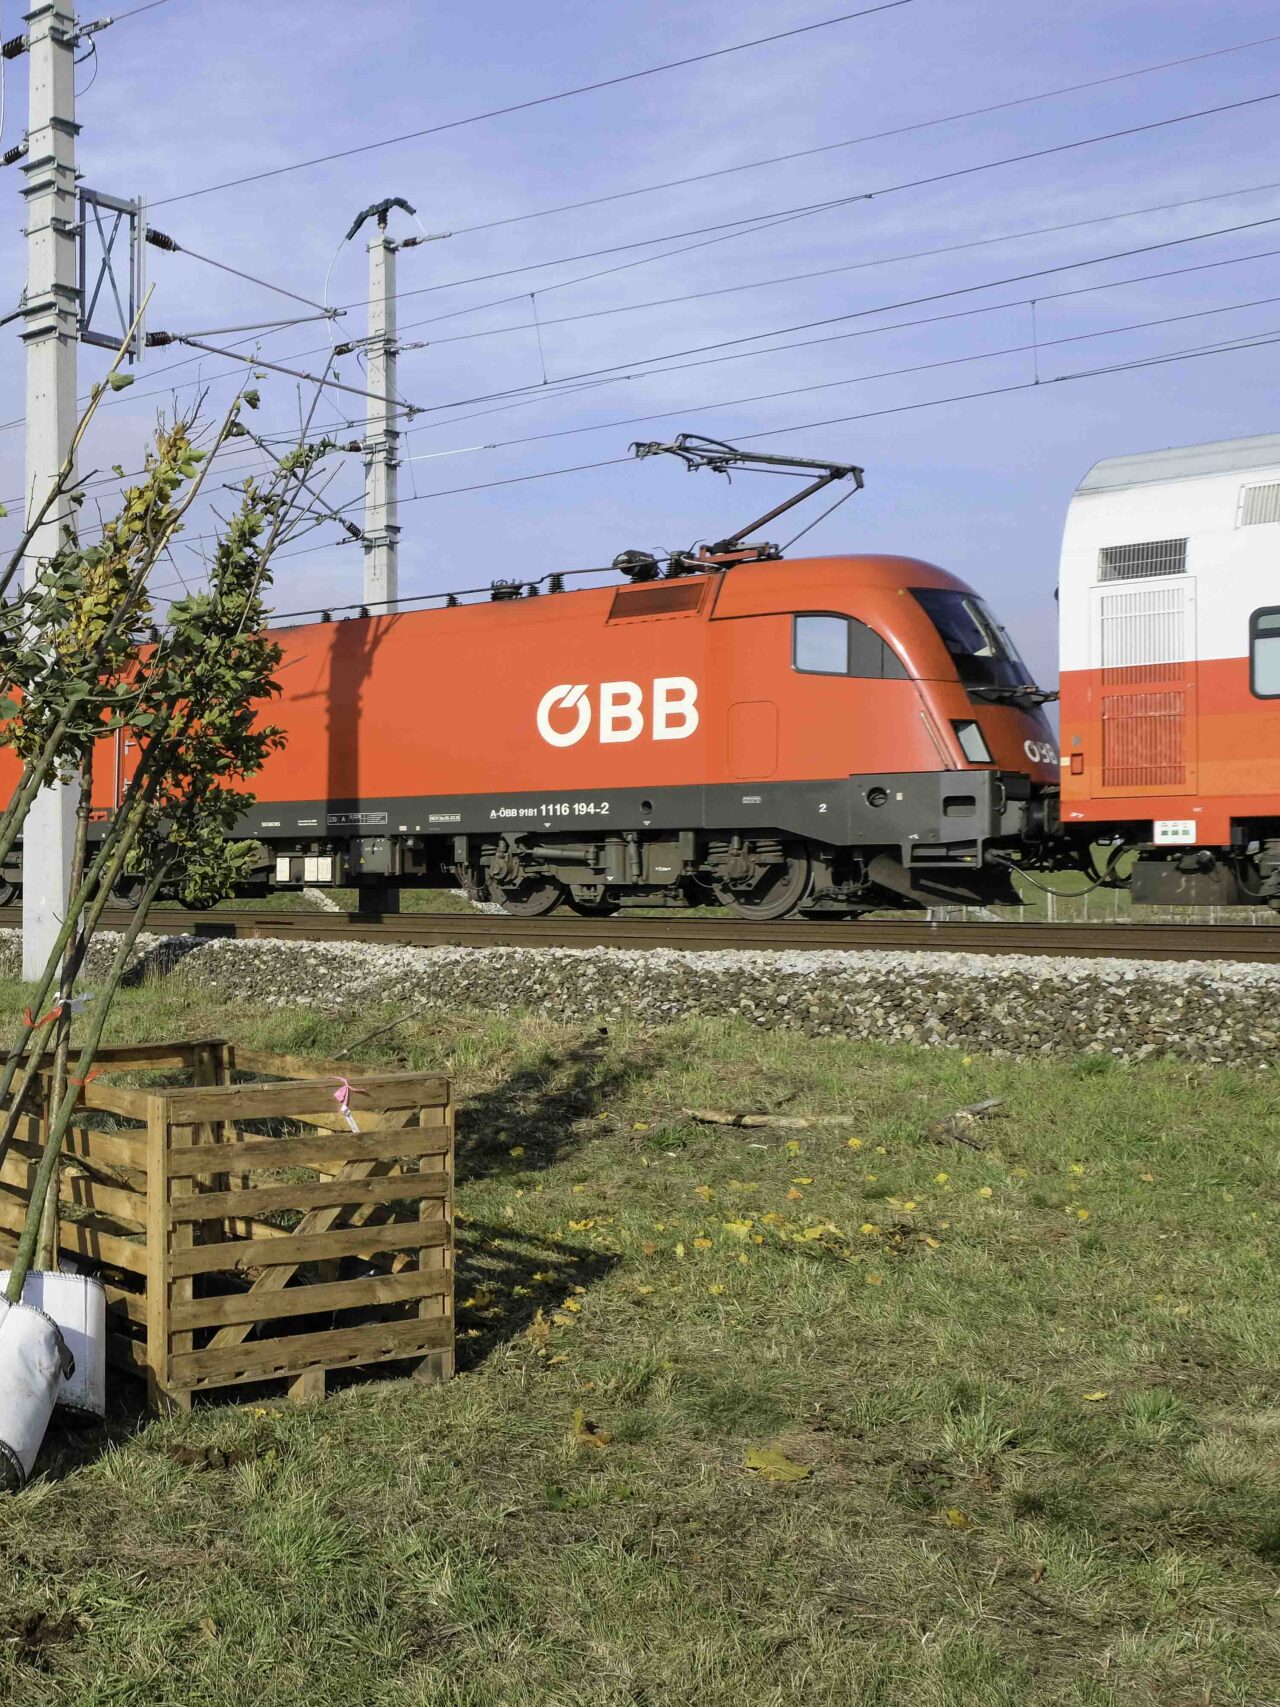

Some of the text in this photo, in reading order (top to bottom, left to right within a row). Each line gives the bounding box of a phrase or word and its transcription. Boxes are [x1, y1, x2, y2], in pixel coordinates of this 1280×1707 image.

[536, 676, 700, 748] ÖBB
[489, 802, 610, 819] A-ÖBB 9181 1116 194-2
[819, 803, 827, 813] 2
